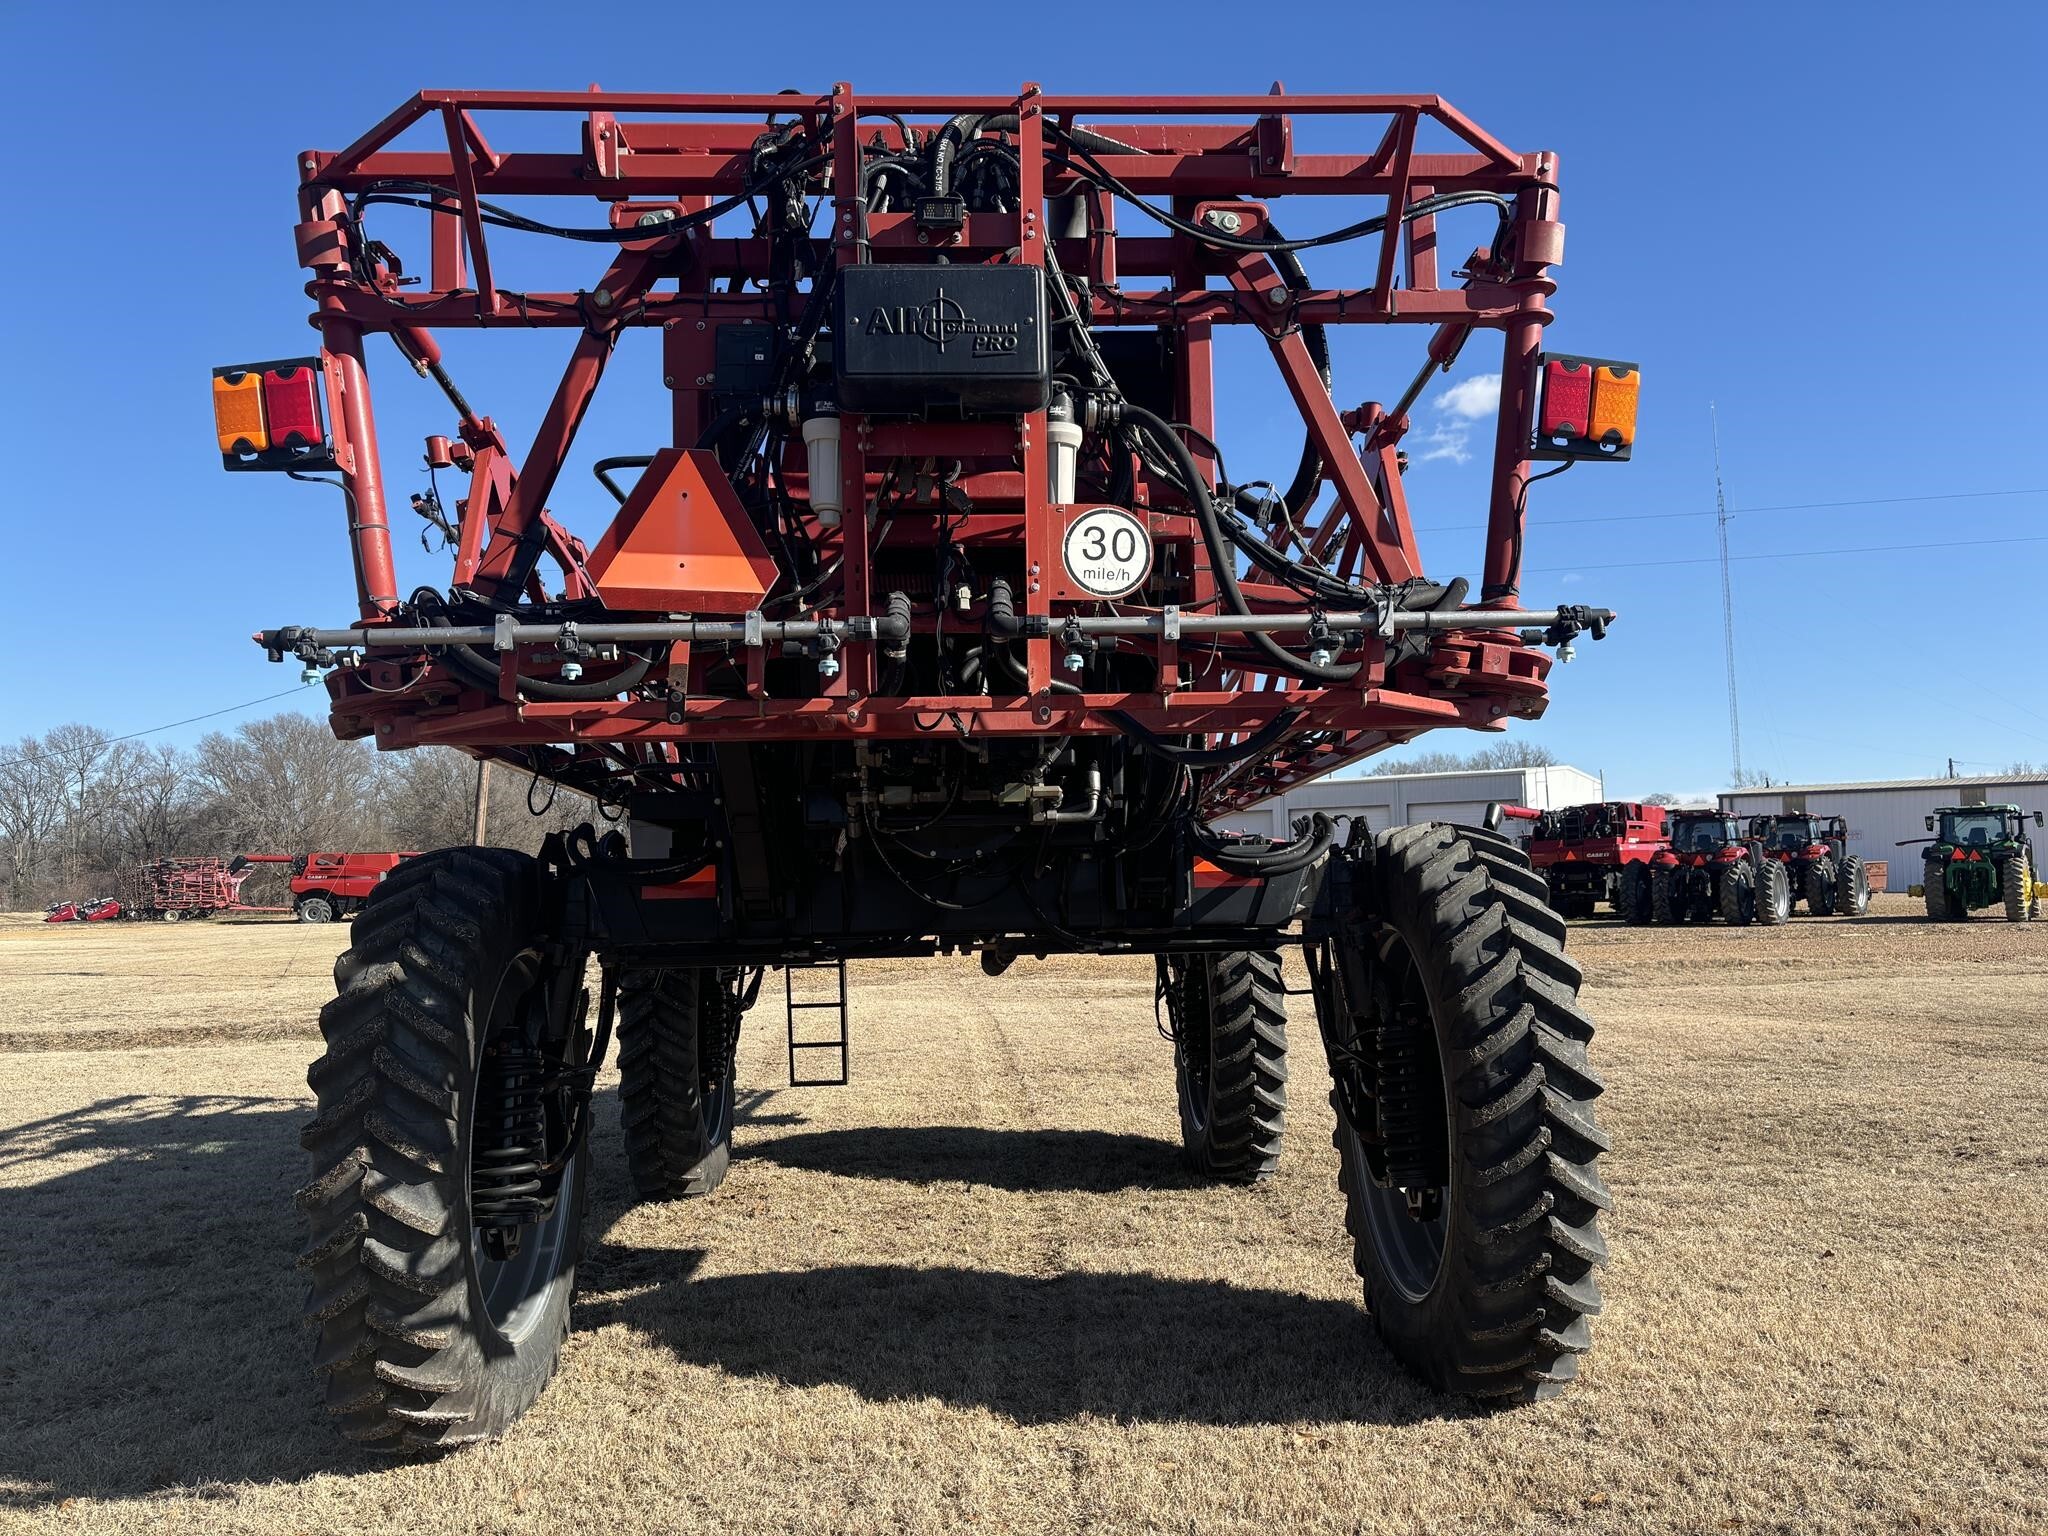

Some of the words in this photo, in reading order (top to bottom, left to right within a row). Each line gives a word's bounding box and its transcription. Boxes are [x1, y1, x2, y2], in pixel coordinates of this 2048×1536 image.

[866, 306, 938, 336] AIM
[945, 322, 1018, 334] Command
[974, 335, 1018, 351] PRO
[1082, 526, 1136, 563] 30
[1083, 567, 1130, 581] mile/h
